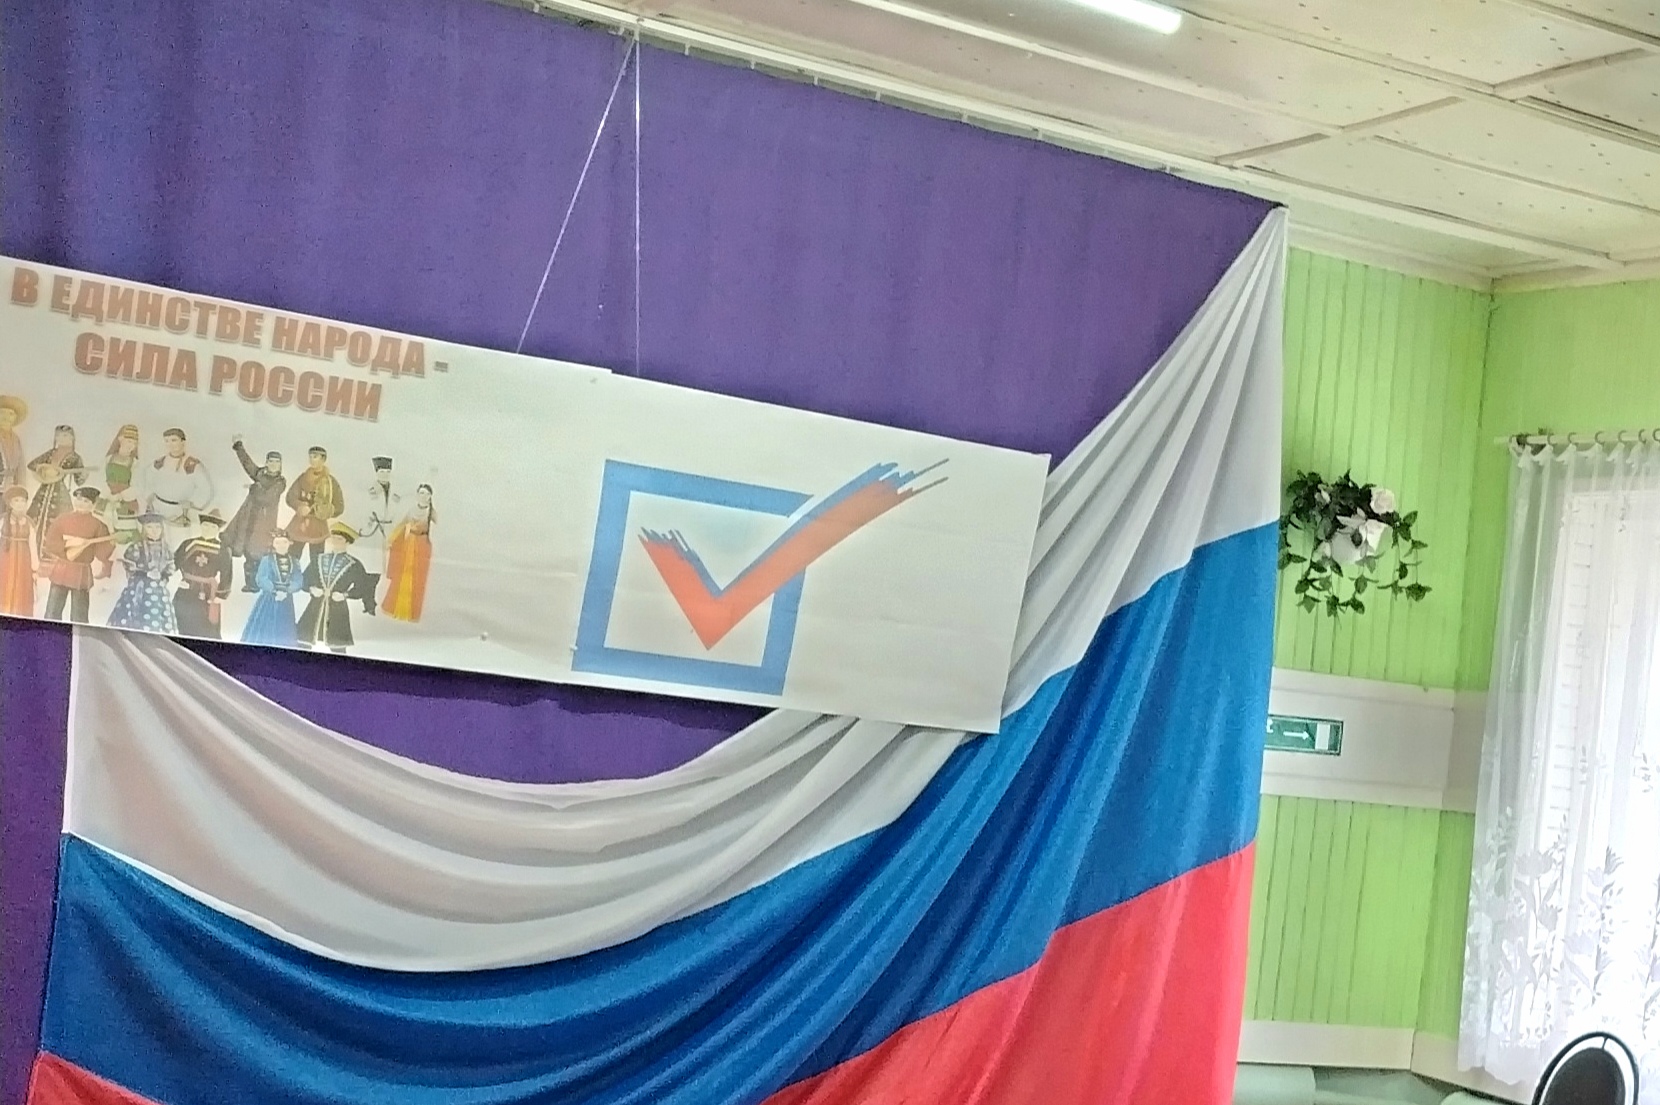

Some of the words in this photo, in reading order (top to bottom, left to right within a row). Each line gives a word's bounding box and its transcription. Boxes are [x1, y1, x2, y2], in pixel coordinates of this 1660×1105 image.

[11, 266, 39, 306] В
[50, 274, 265, 347] ЕДИНСТВЕ
[271, 315, 427, 379] НАРОДА
[73, 332, 199, 392] СИЛА
[208, 354, 383, 422] РОССИИ
